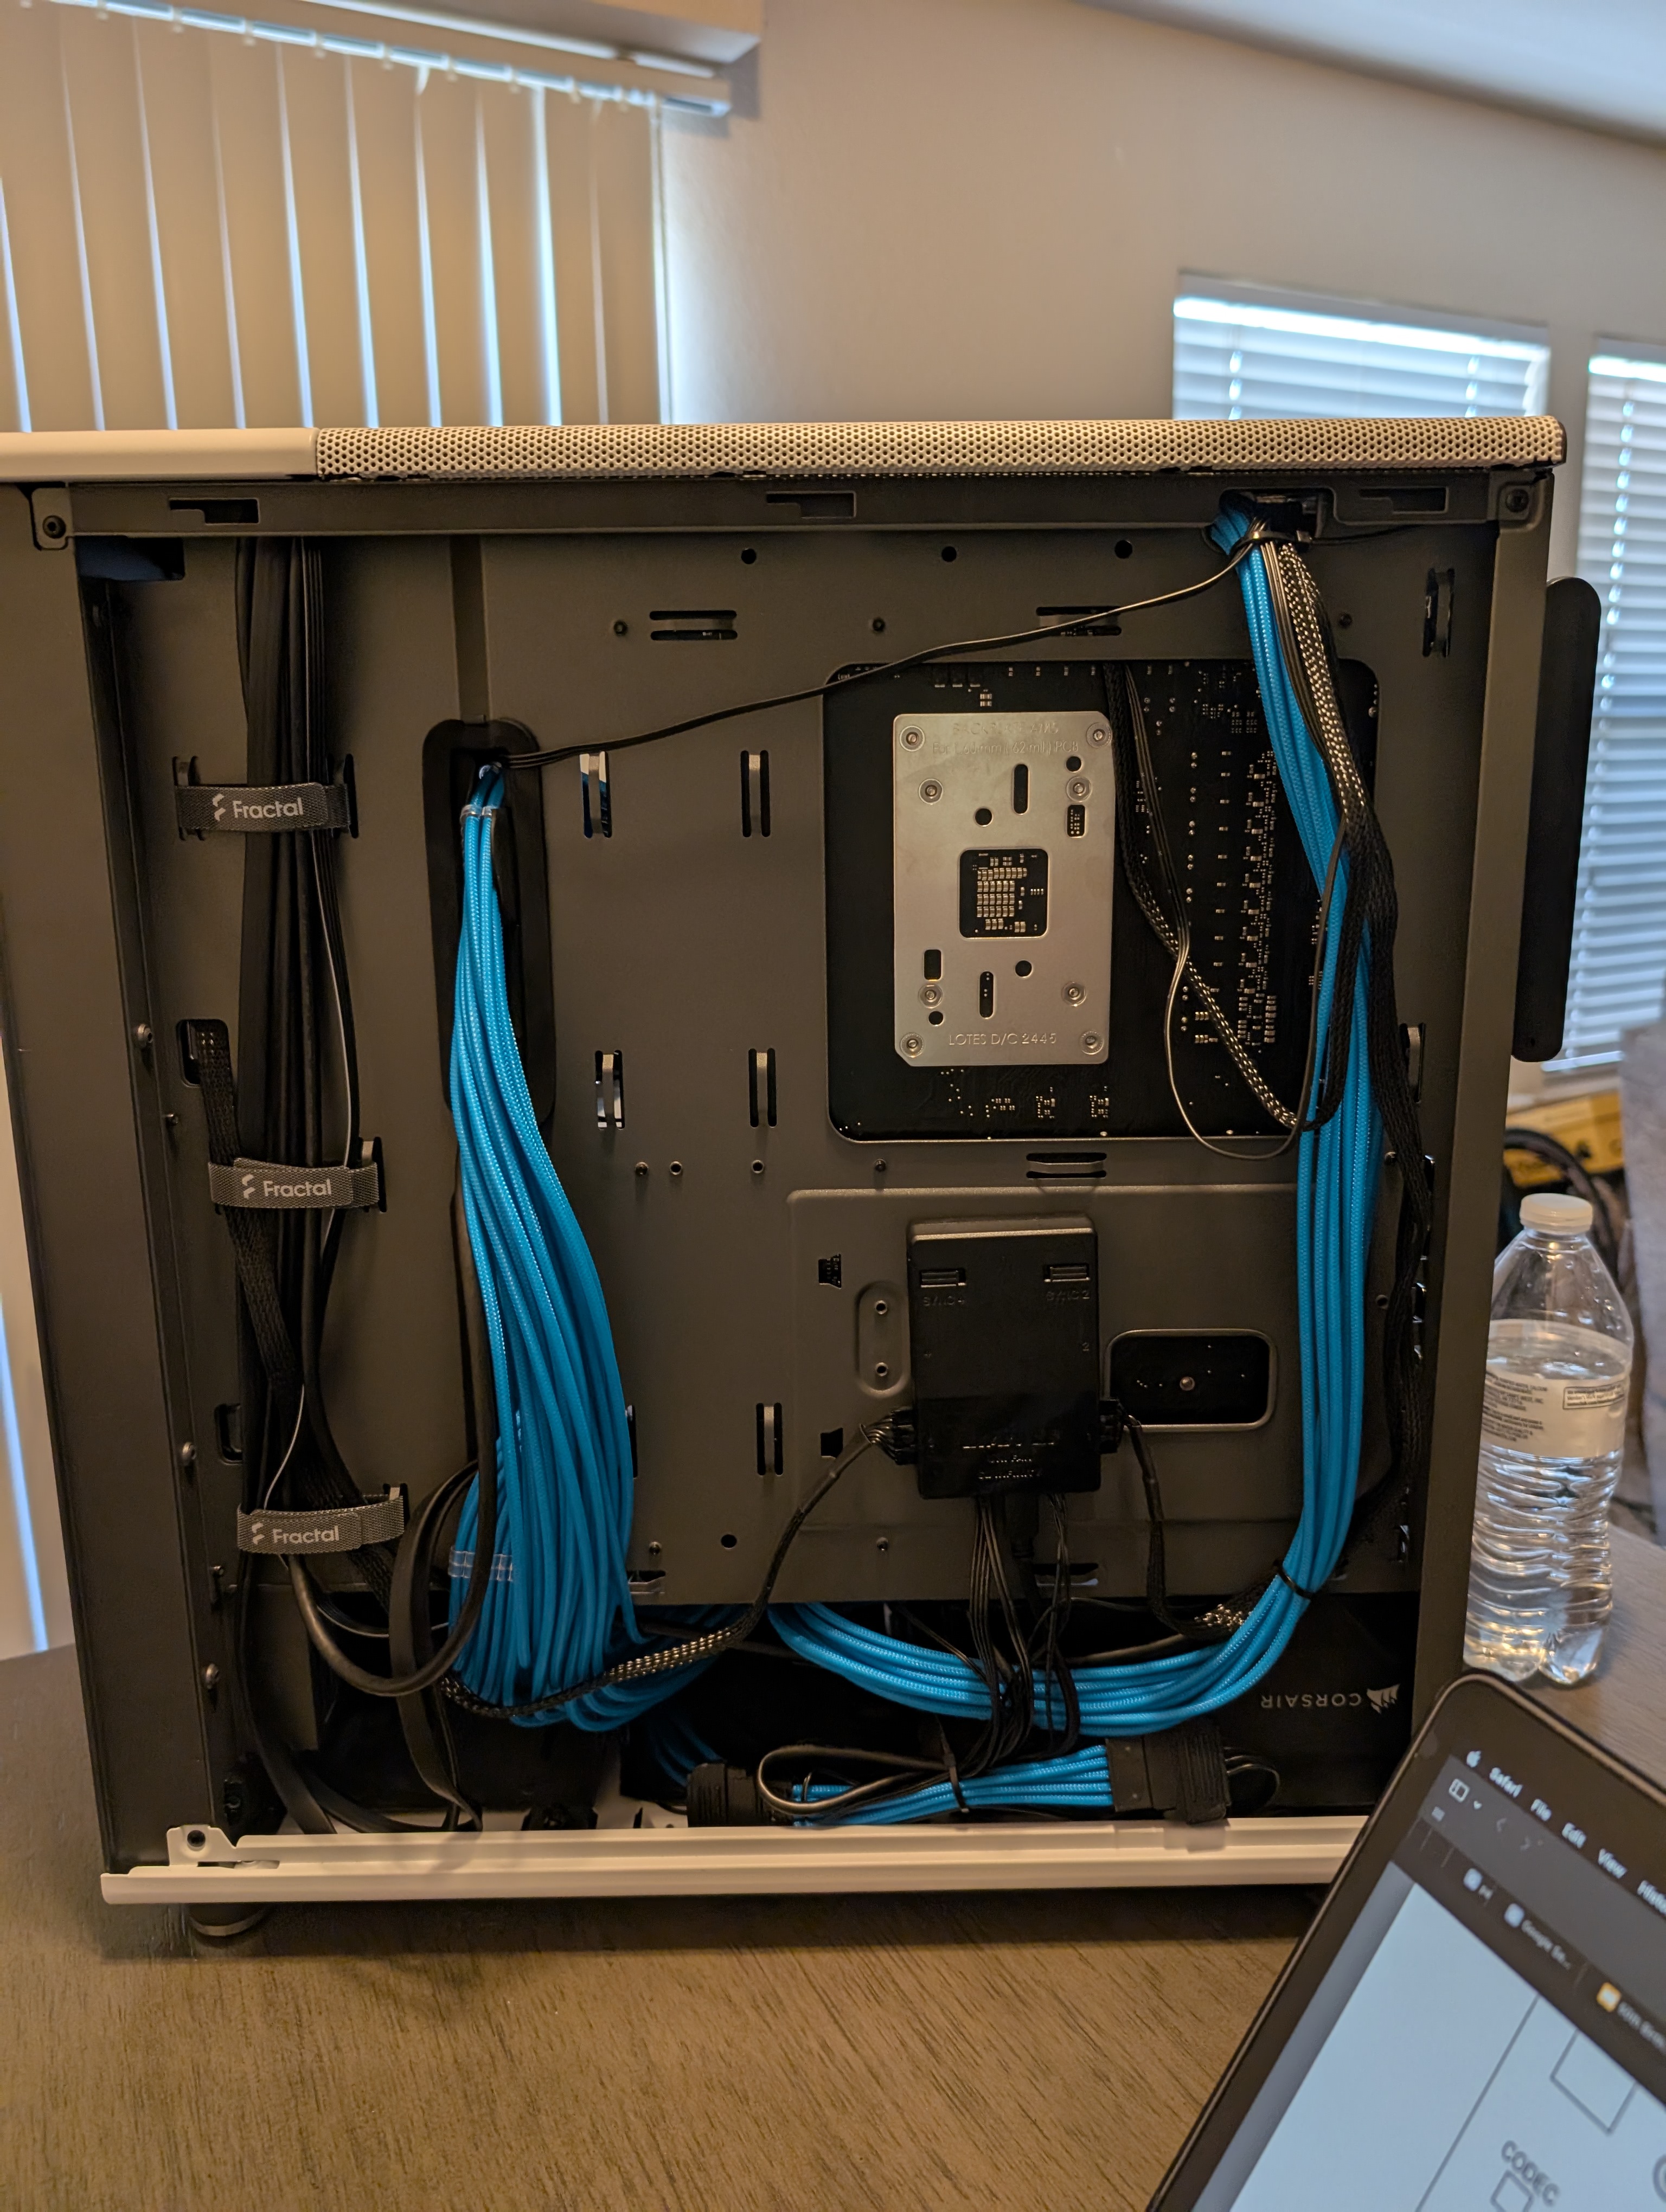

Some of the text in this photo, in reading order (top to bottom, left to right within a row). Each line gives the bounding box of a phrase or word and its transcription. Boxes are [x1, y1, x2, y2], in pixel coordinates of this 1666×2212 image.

[1030, 721, 1059, 734] AM5
[1055, 741, 1079, 753] PCB
[232, 798, 304, 819] Fractal
[949, 1032, 1056, 1045] LOTES D/C 2445
[263, 1179, 332, 1197] Fractal
[272, 1525, 339, 1544] Fractal
[1260, 1693, 1362, 1708] CORSAIR
[1489, 1766, 1523, 1798] Safari
[1530, 1798, 1552, 1822] File
[1561, 1822, 1587, 1849] Edit
[1598, 1848, 1627, 1880] View
[1501, 2139, 1561, 2207] CODEC
